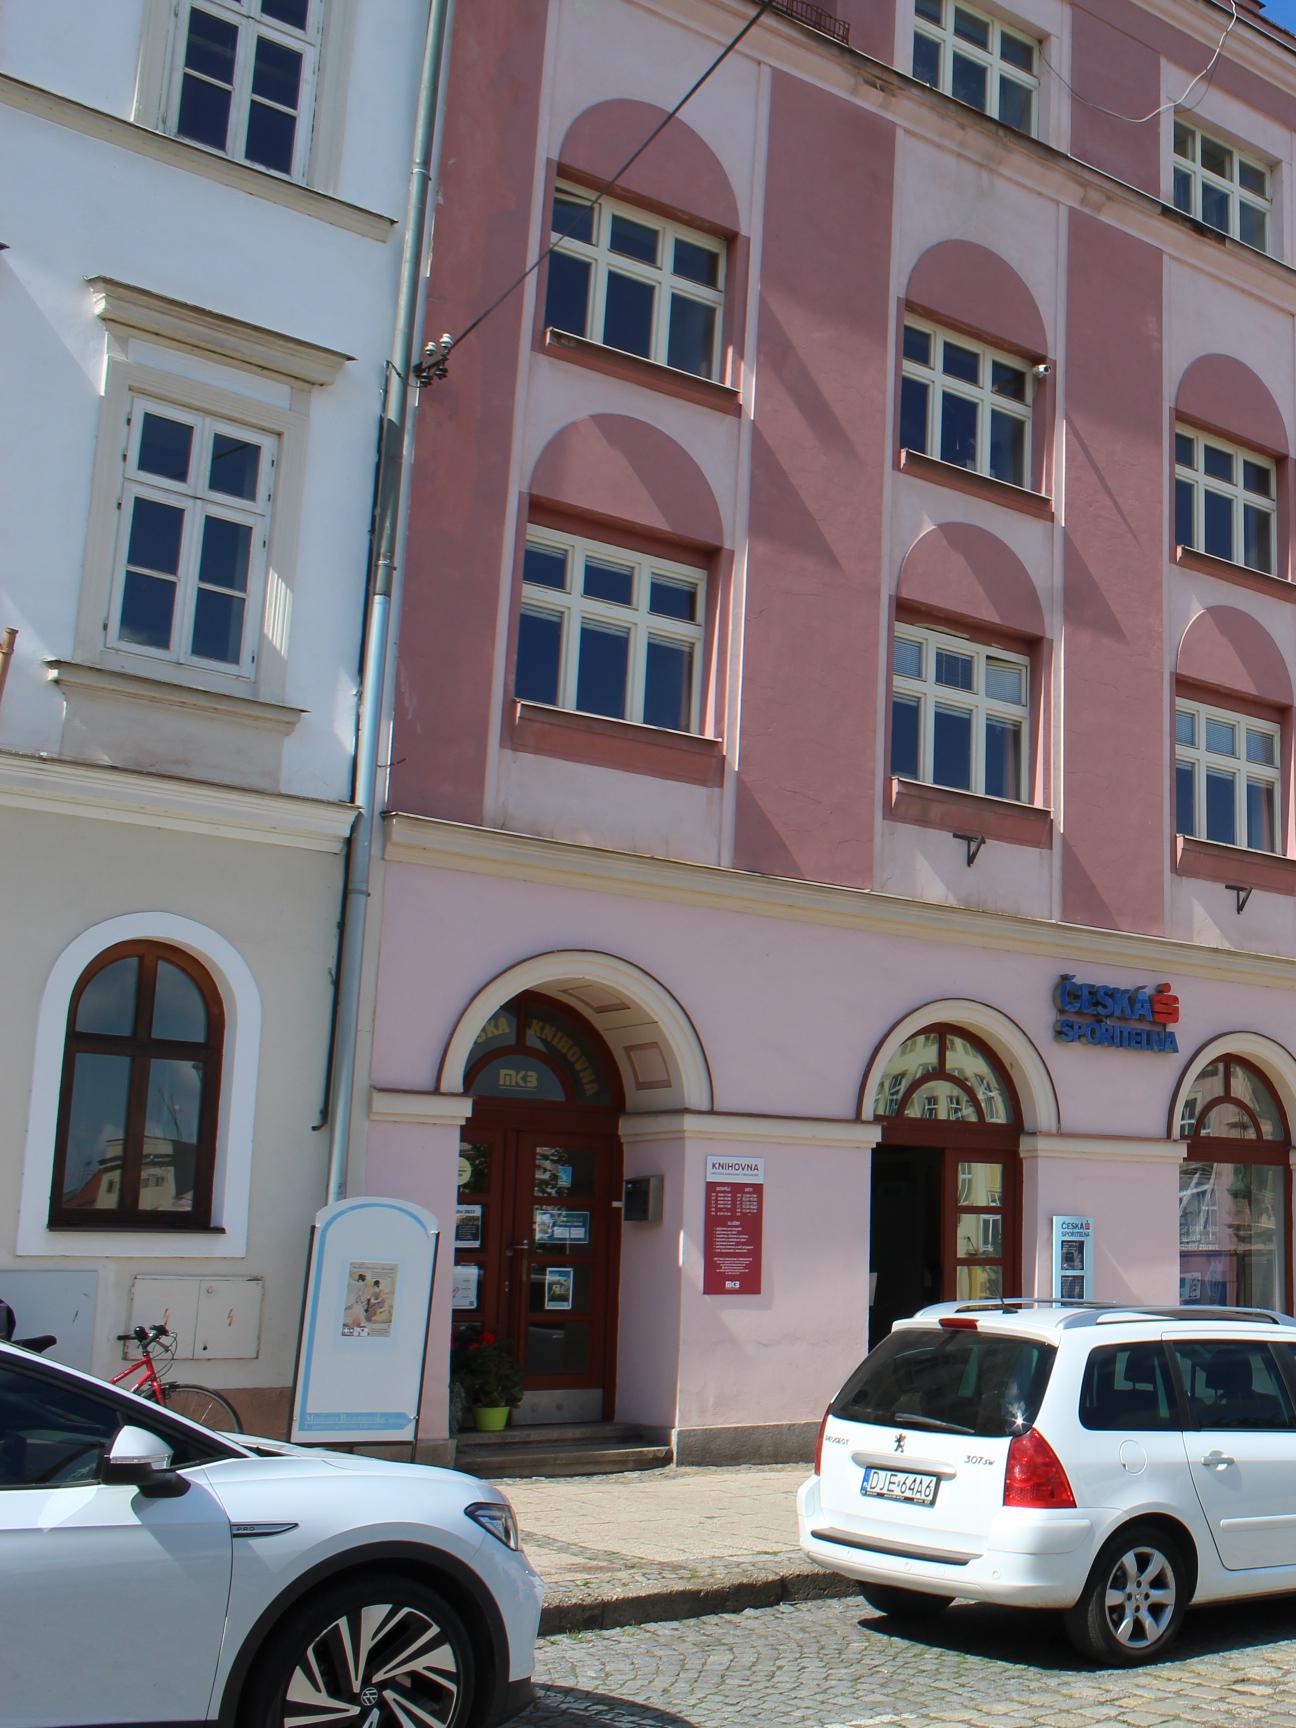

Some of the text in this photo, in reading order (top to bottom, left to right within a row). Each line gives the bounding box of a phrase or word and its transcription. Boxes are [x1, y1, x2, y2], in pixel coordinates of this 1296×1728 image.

[1054, 974, 1152, 1020] ČESKÁ
[1055, 1019, 1179, 1053] SPOŘITELNA
[530, 1018, 599, 1097] KNIHOVNA
[711, 1161, 760, 1172] KNIHOVNA
[964, 1455, 984, 1464] 307
[869, 1471, 899, 1492] DJE
[900, 1476, 934, 1498] 64A6
